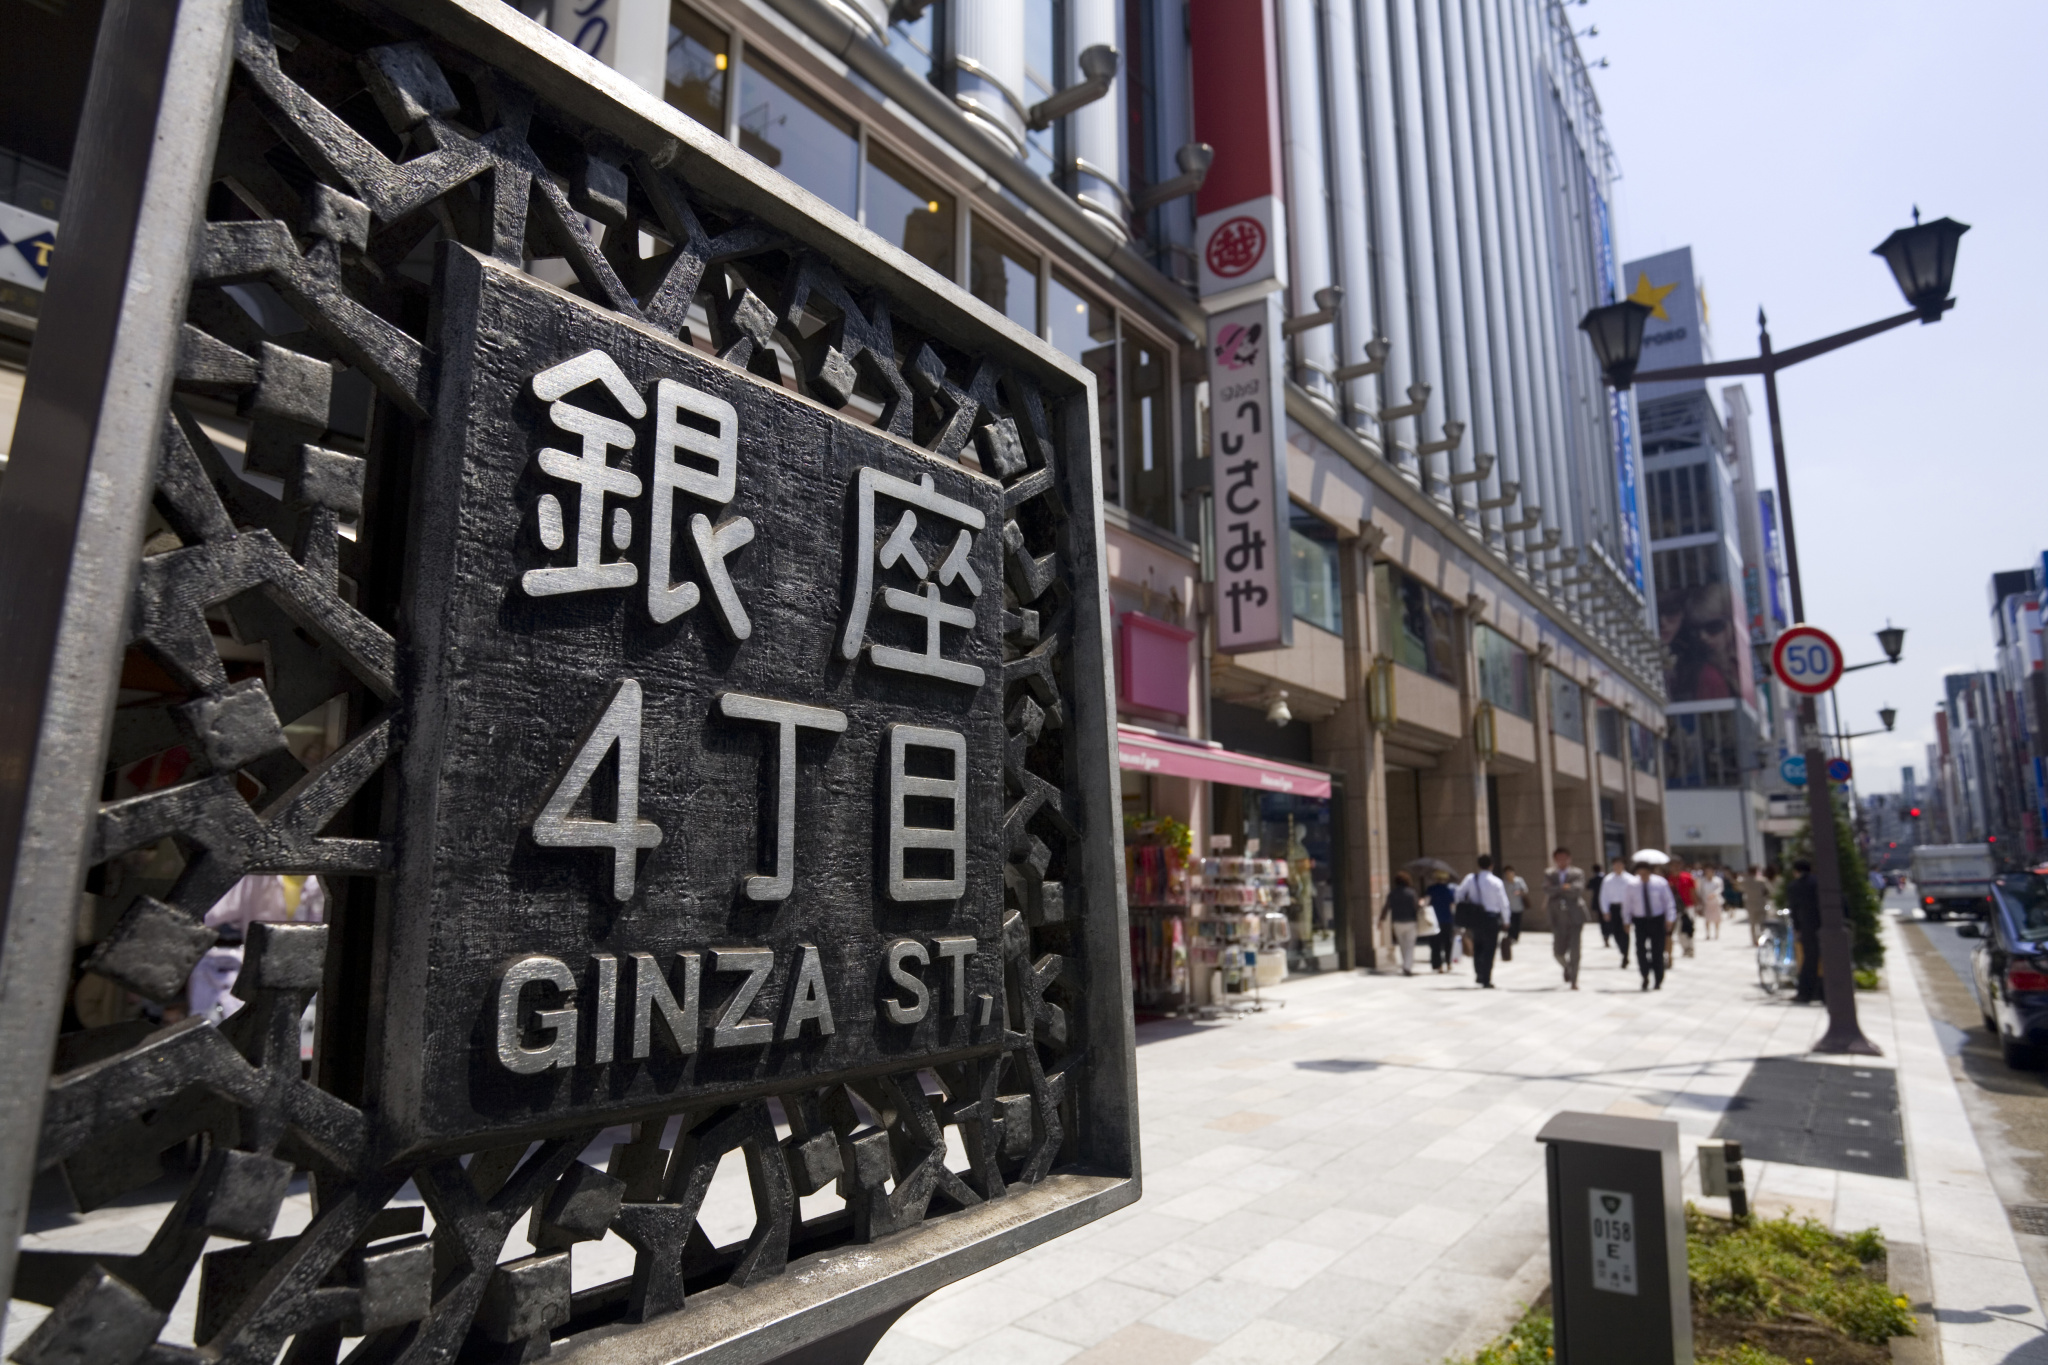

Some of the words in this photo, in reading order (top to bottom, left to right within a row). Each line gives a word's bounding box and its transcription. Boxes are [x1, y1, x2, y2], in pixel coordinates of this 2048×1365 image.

[522, 349, 987, 688] 銀座
[1786, 645, 1829, 676] 50
[532, 678, 967, 901] 4丁目
[497, 942, 836, 1074] GINZA
[1594, 1218, 1632, 1243] 0158
[1607, 1244, 1620, 1260] E
